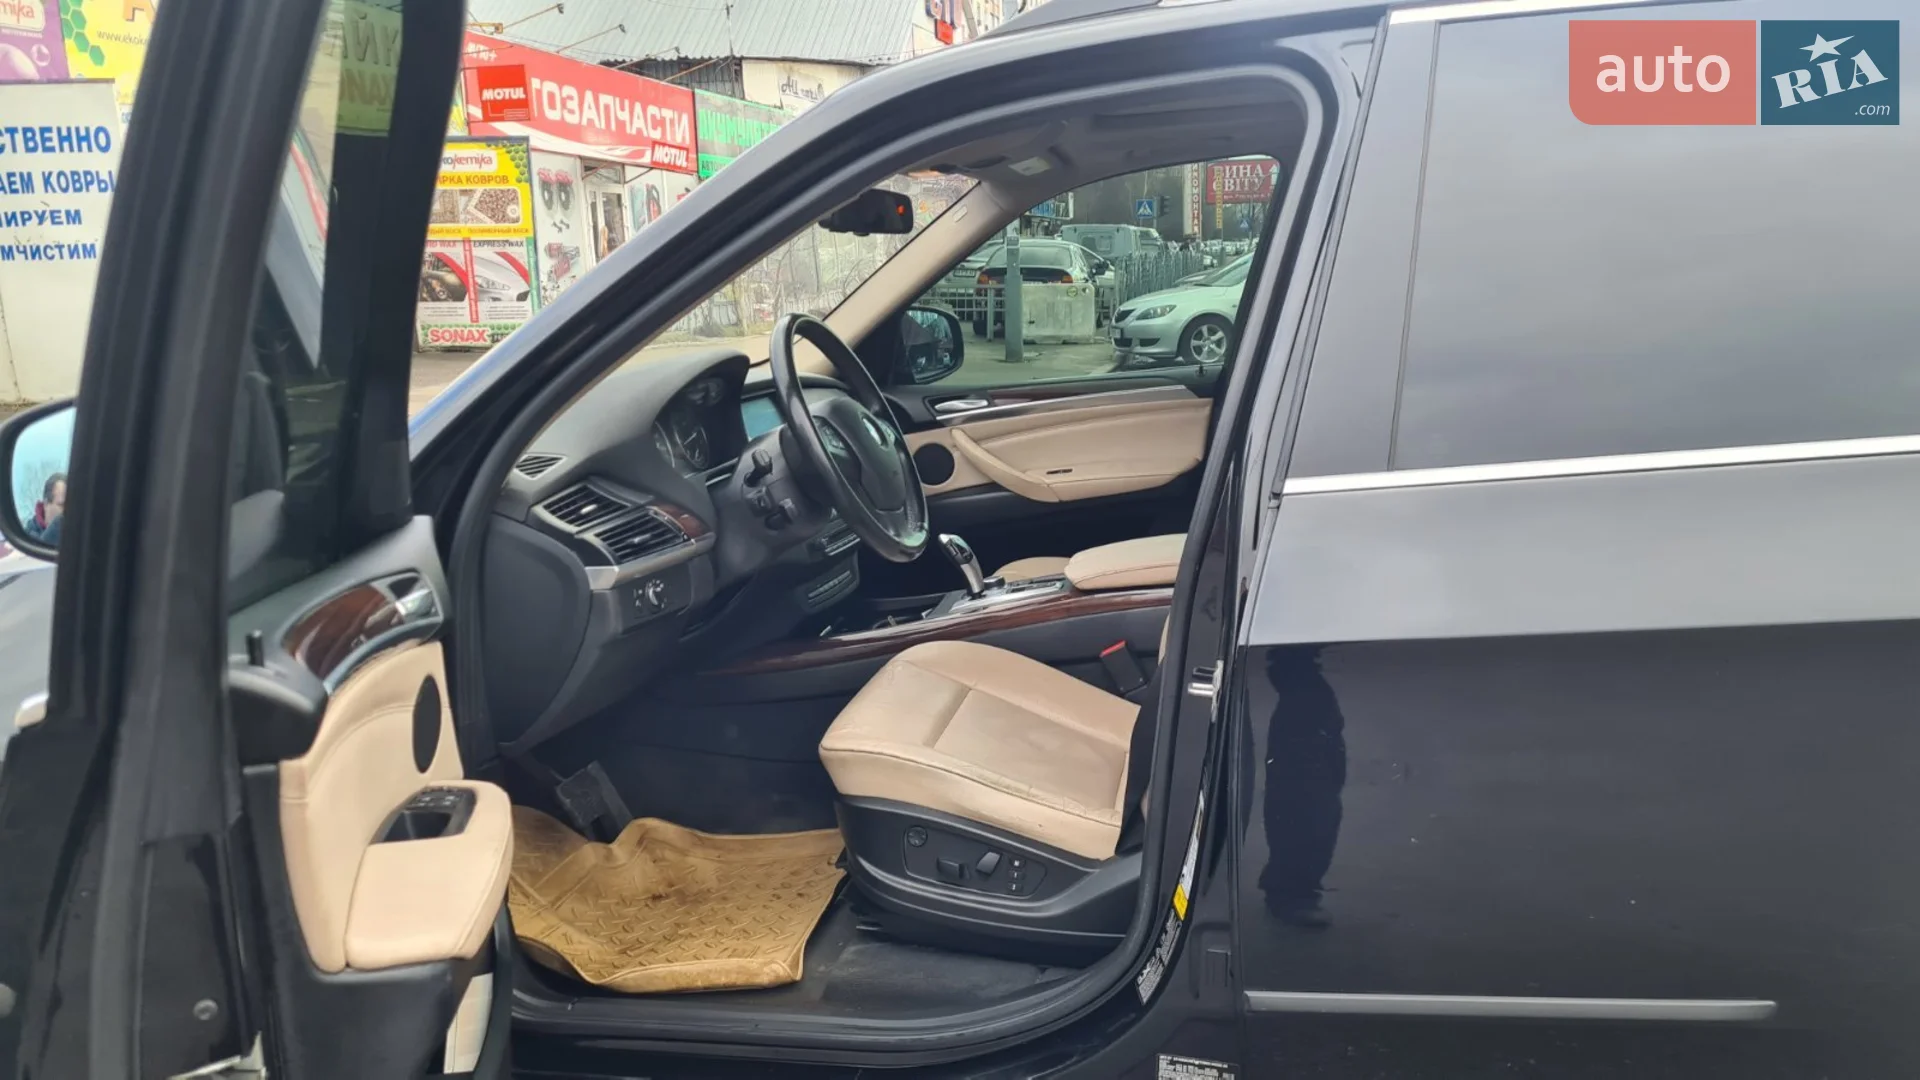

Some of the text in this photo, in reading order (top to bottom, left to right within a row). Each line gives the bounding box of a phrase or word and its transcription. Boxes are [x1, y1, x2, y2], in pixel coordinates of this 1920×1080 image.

[481, 86, 527, 101] MOTUL
[653, 144, 688, 167] MOTUL
[42, 170, 116, 193] КОВРЫ
[465, 174, 510, 185] КОВРОВ
[0, 209, 82, 228] ИРУЕМ
[429, 327, 489, 343] SONAX
